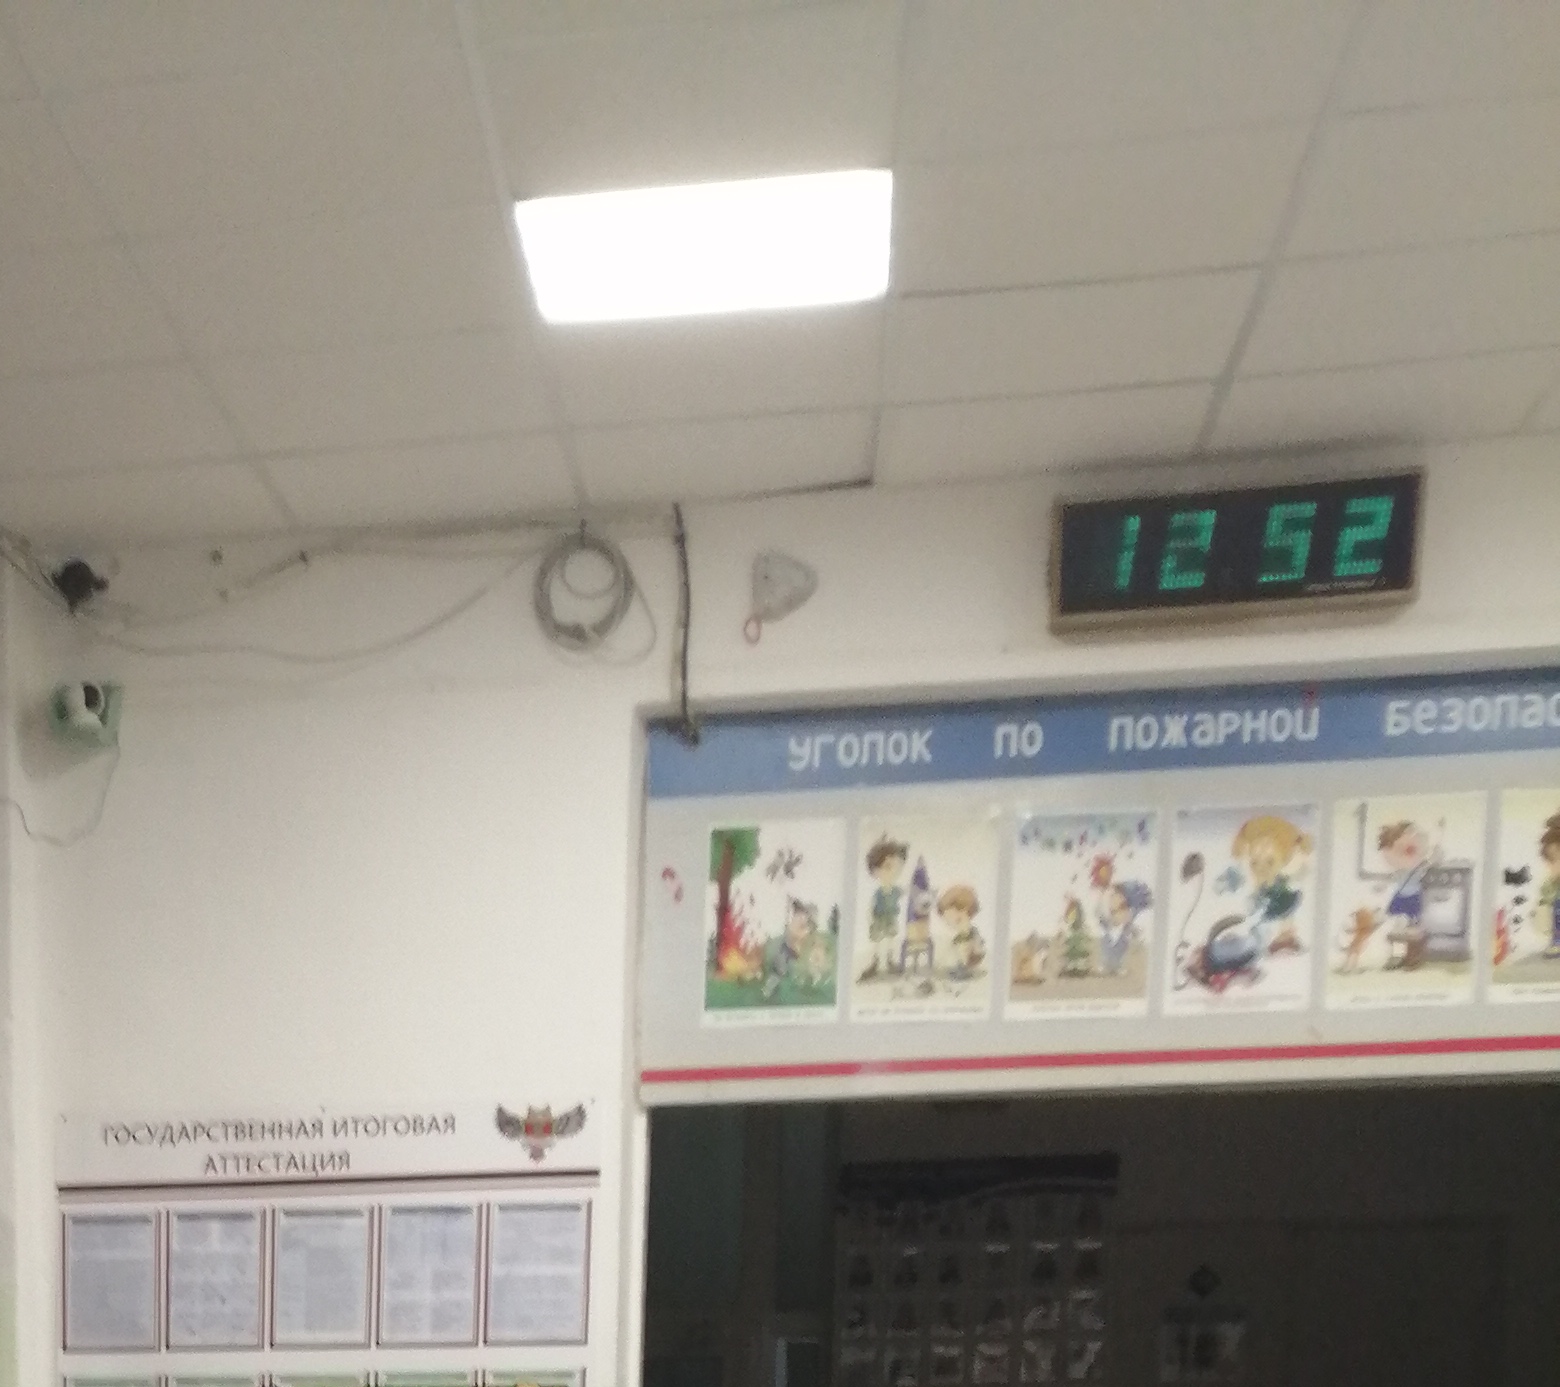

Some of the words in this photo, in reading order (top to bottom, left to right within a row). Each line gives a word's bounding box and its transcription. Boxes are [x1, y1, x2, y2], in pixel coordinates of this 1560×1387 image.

[1115, 509, 1217, 591] 12
[1257, 496, 1395, 582] 52
[102, 1116, 323, 1149] ГОСУДАРСТВЕННАЯ
[332, 1112, 456, 1140] ИТОГОВАЯ
[204, 1150, 351, 1177] АТТЕСТАЦИЯ
